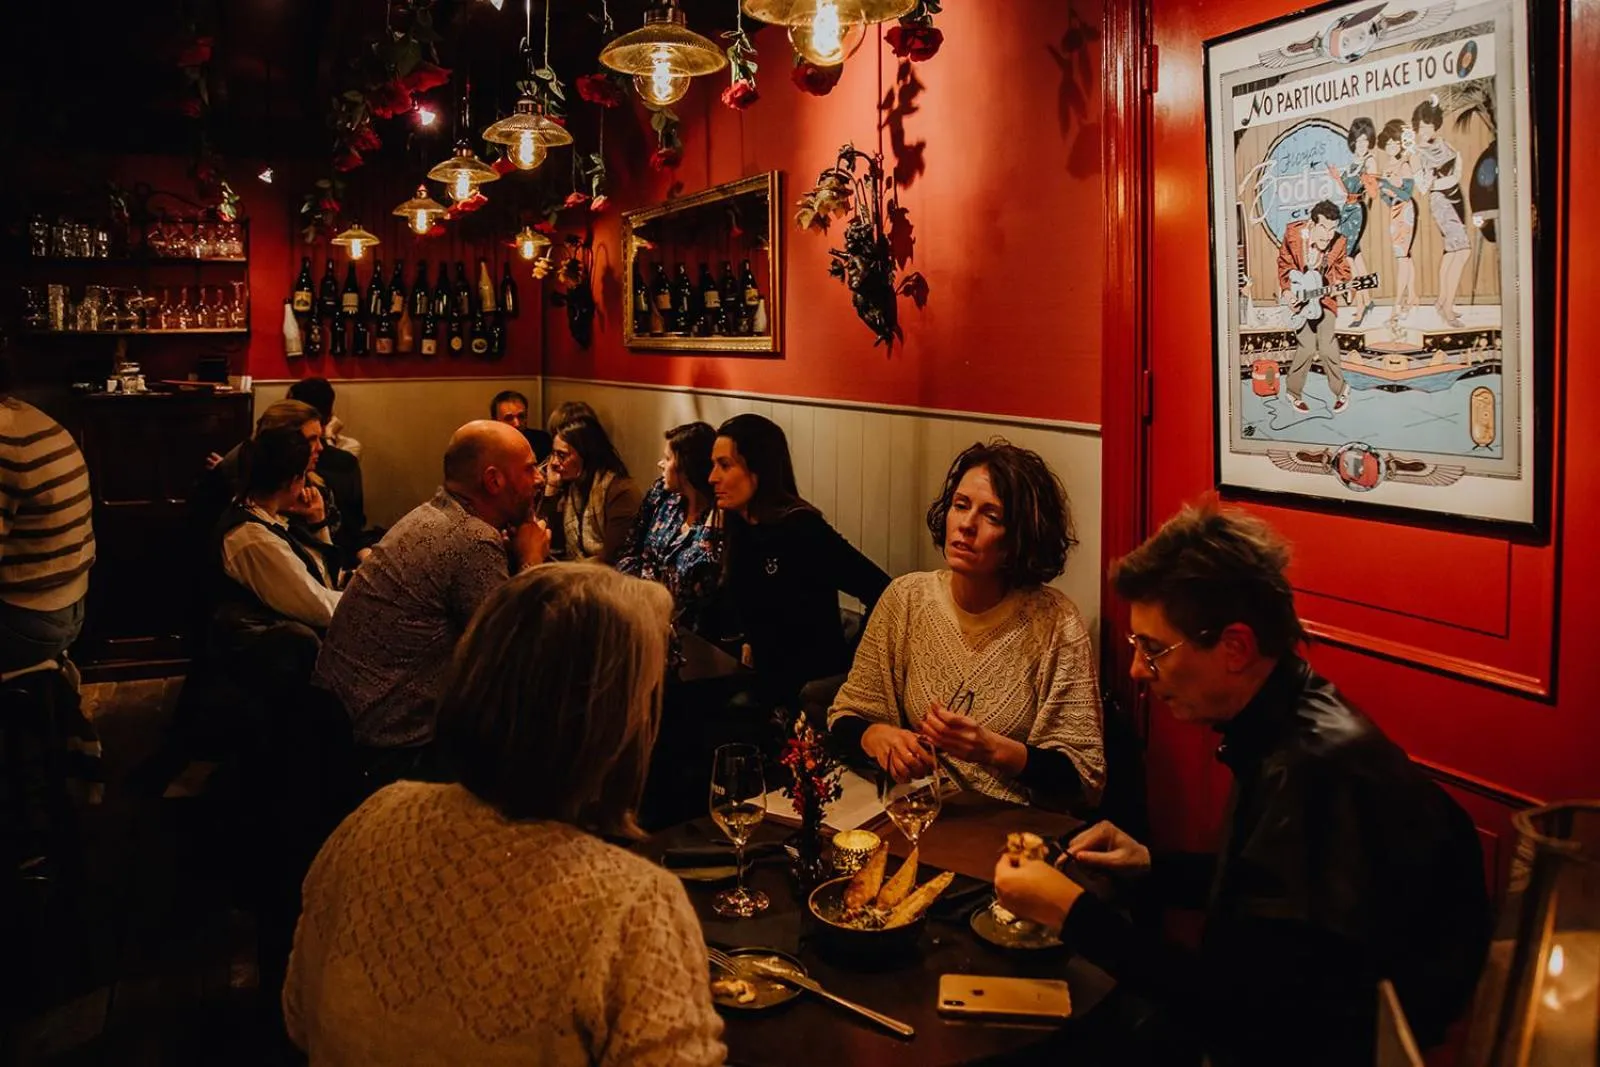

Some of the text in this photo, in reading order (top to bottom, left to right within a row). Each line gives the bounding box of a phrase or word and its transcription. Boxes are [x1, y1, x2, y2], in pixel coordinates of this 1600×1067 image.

[1241, 40, 1478, 126] NO PARTICULAR PLACE TO GO
